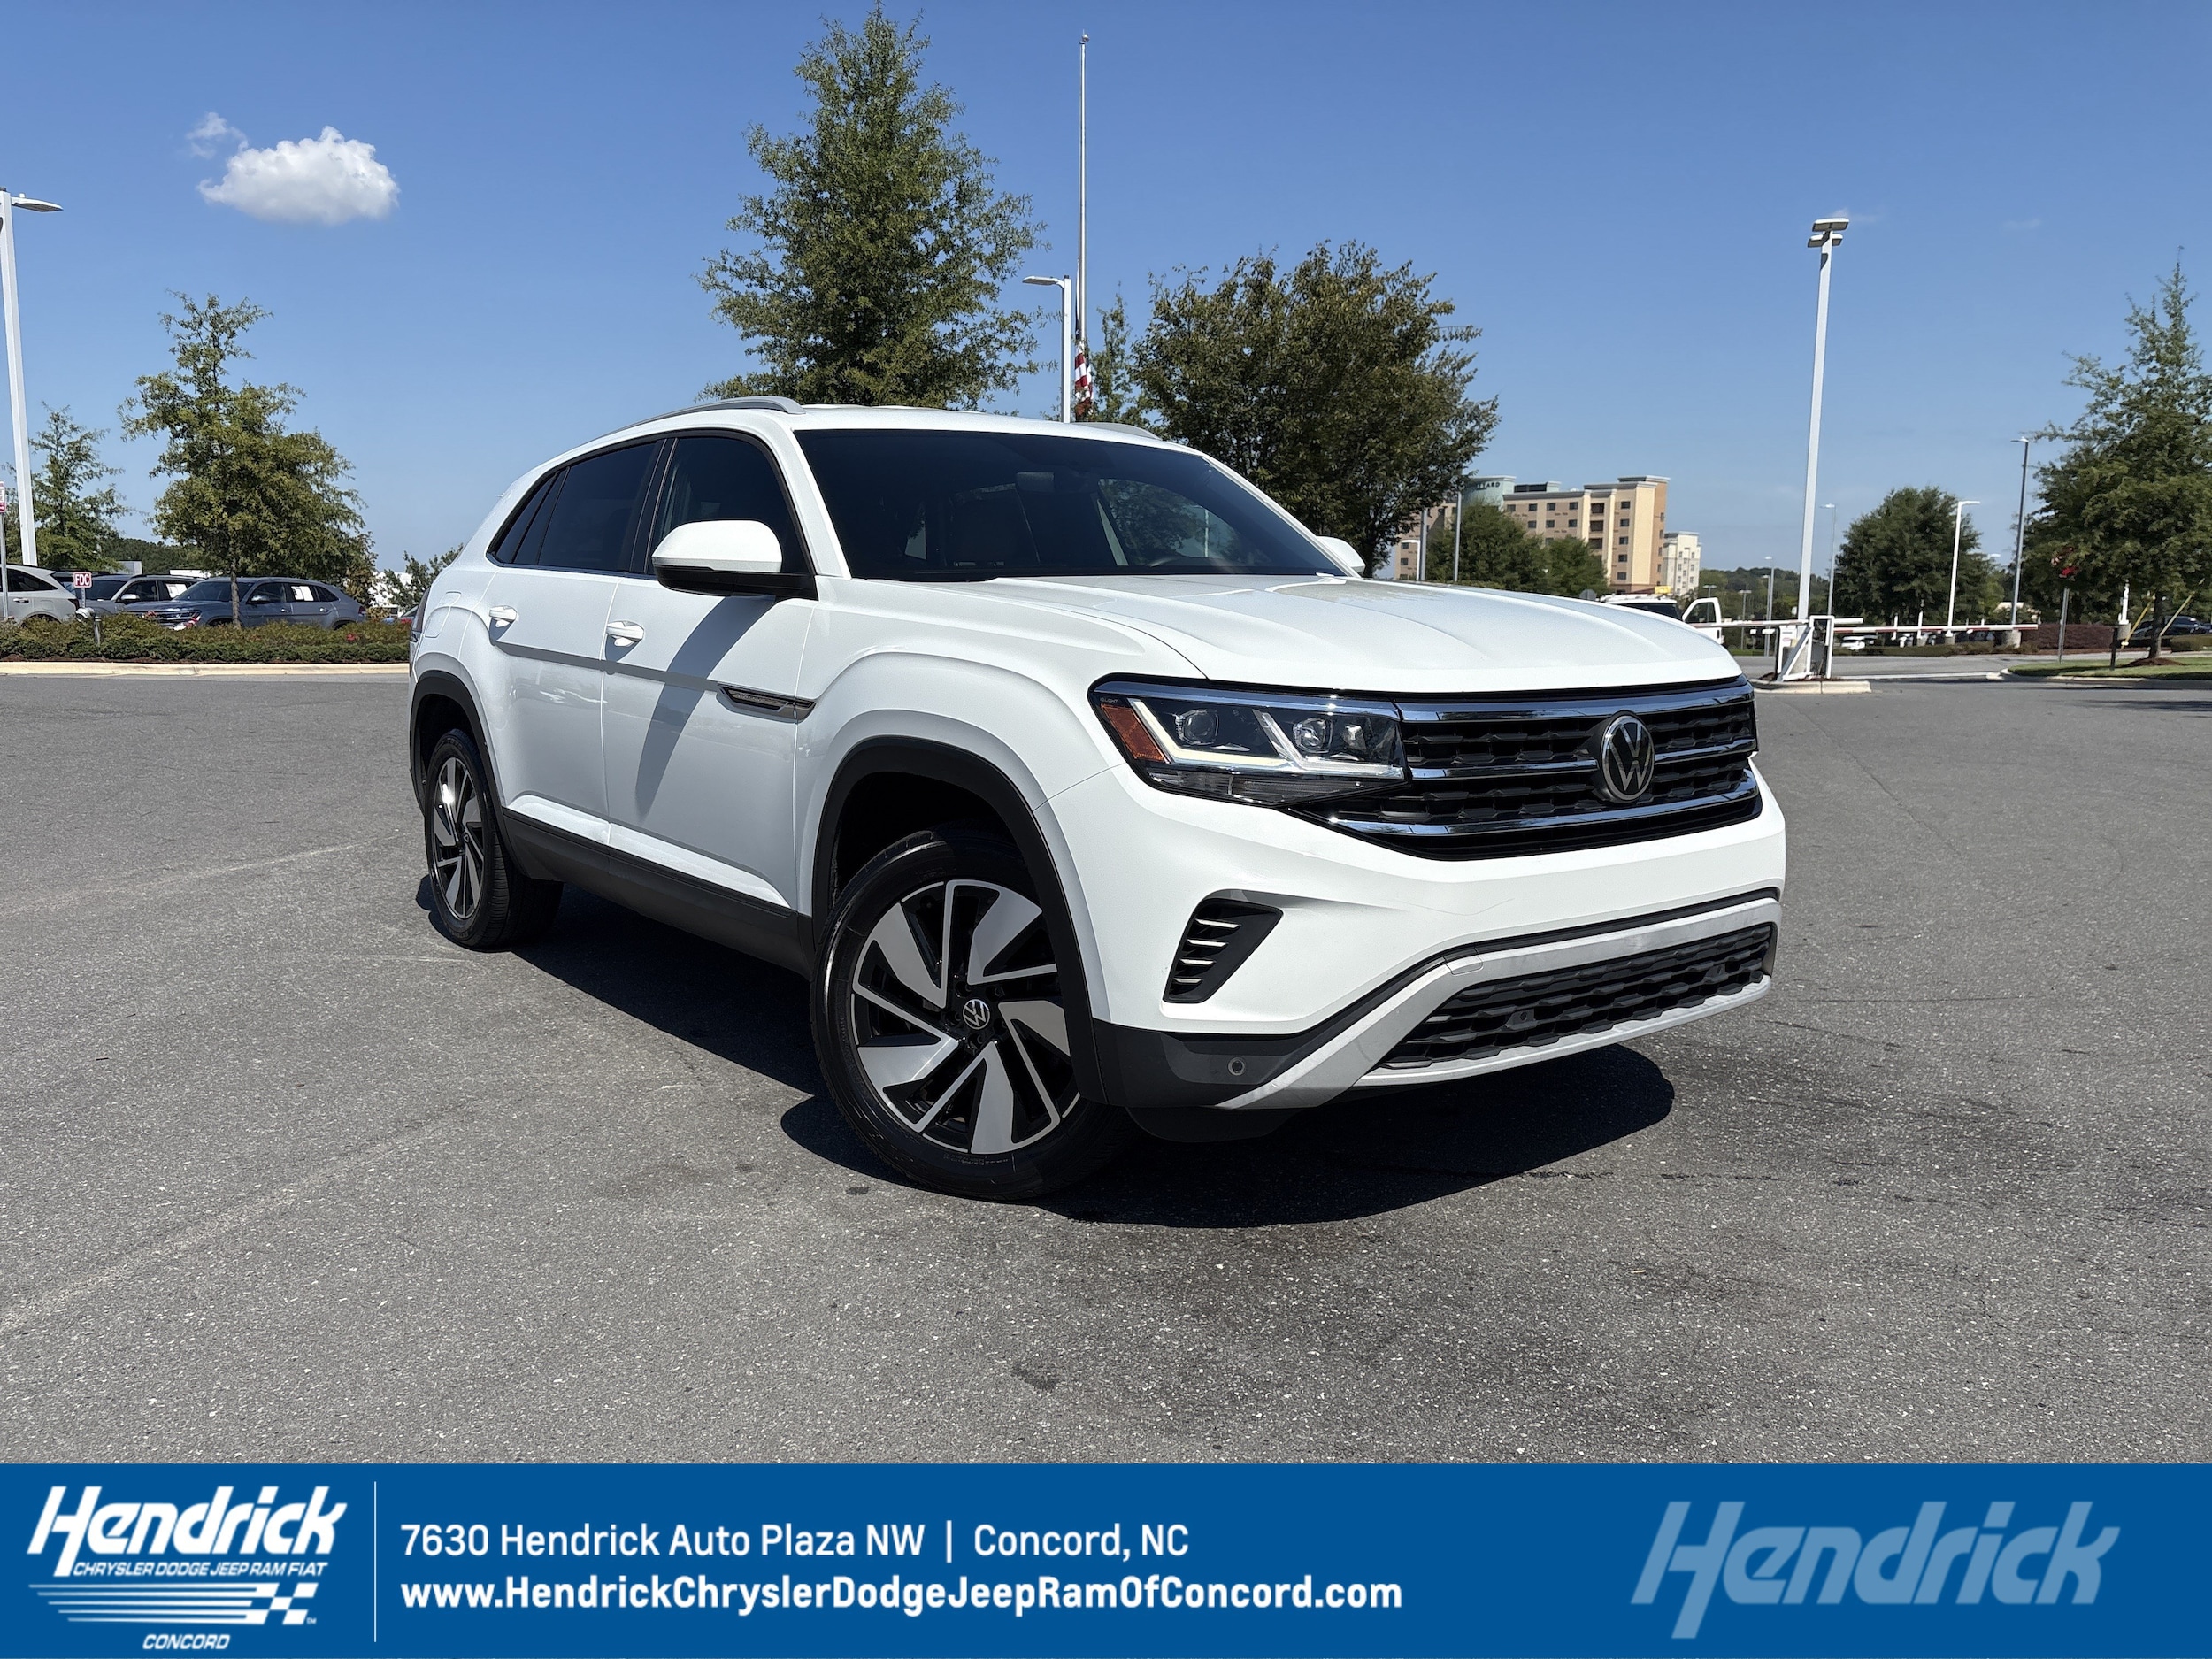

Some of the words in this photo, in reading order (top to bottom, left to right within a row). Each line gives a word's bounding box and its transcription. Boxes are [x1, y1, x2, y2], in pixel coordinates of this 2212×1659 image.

[75, 573, 90, 586] FDC
[1601, 715, 1655, 801] VW
[963, 999, 990, 1030] VW
